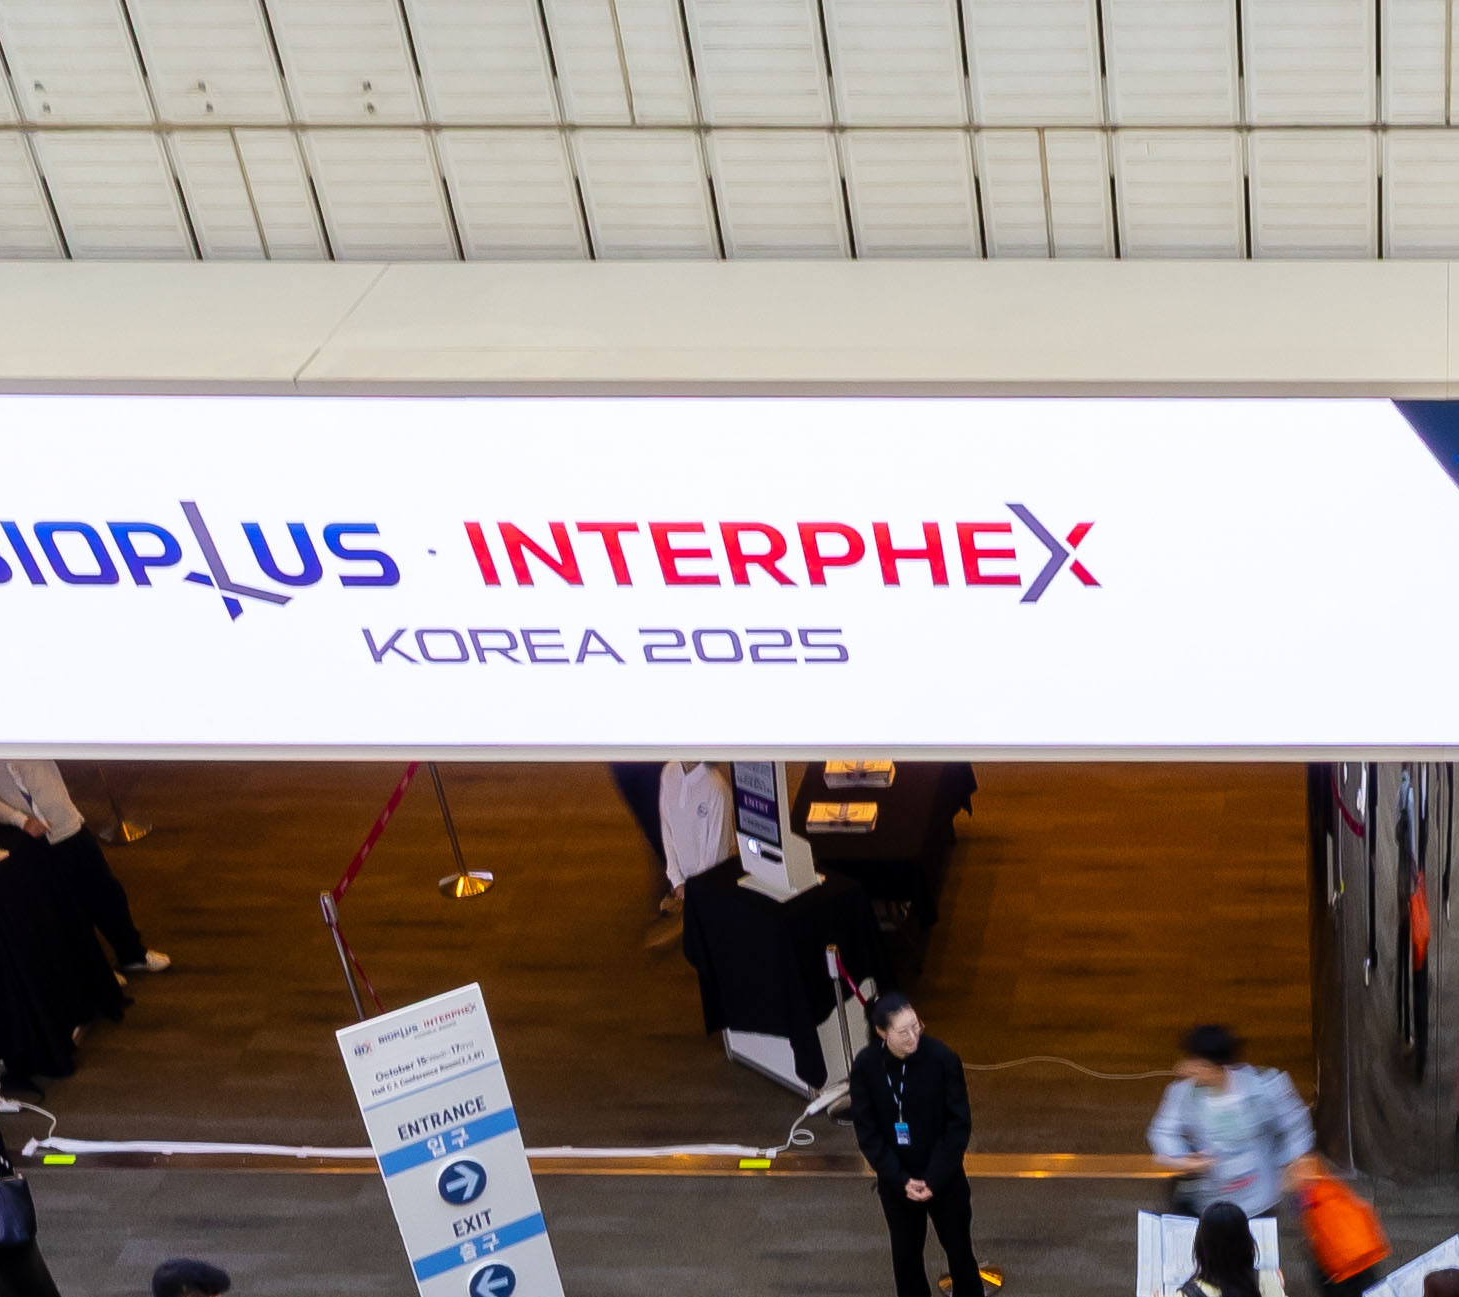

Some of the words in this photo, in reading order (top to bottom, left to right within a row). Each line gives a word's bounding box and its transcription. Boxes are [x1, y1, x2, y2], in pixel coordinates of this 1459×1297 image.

[463, 502, 1103, 604] INTERPHEX
[361, 626, 625, 664] KOREA
[639, 626, 850, 664] 2025
[397, 1095, 486, 1143] ENTRANCE
[452, 1209, 493, 1240] EXIT
